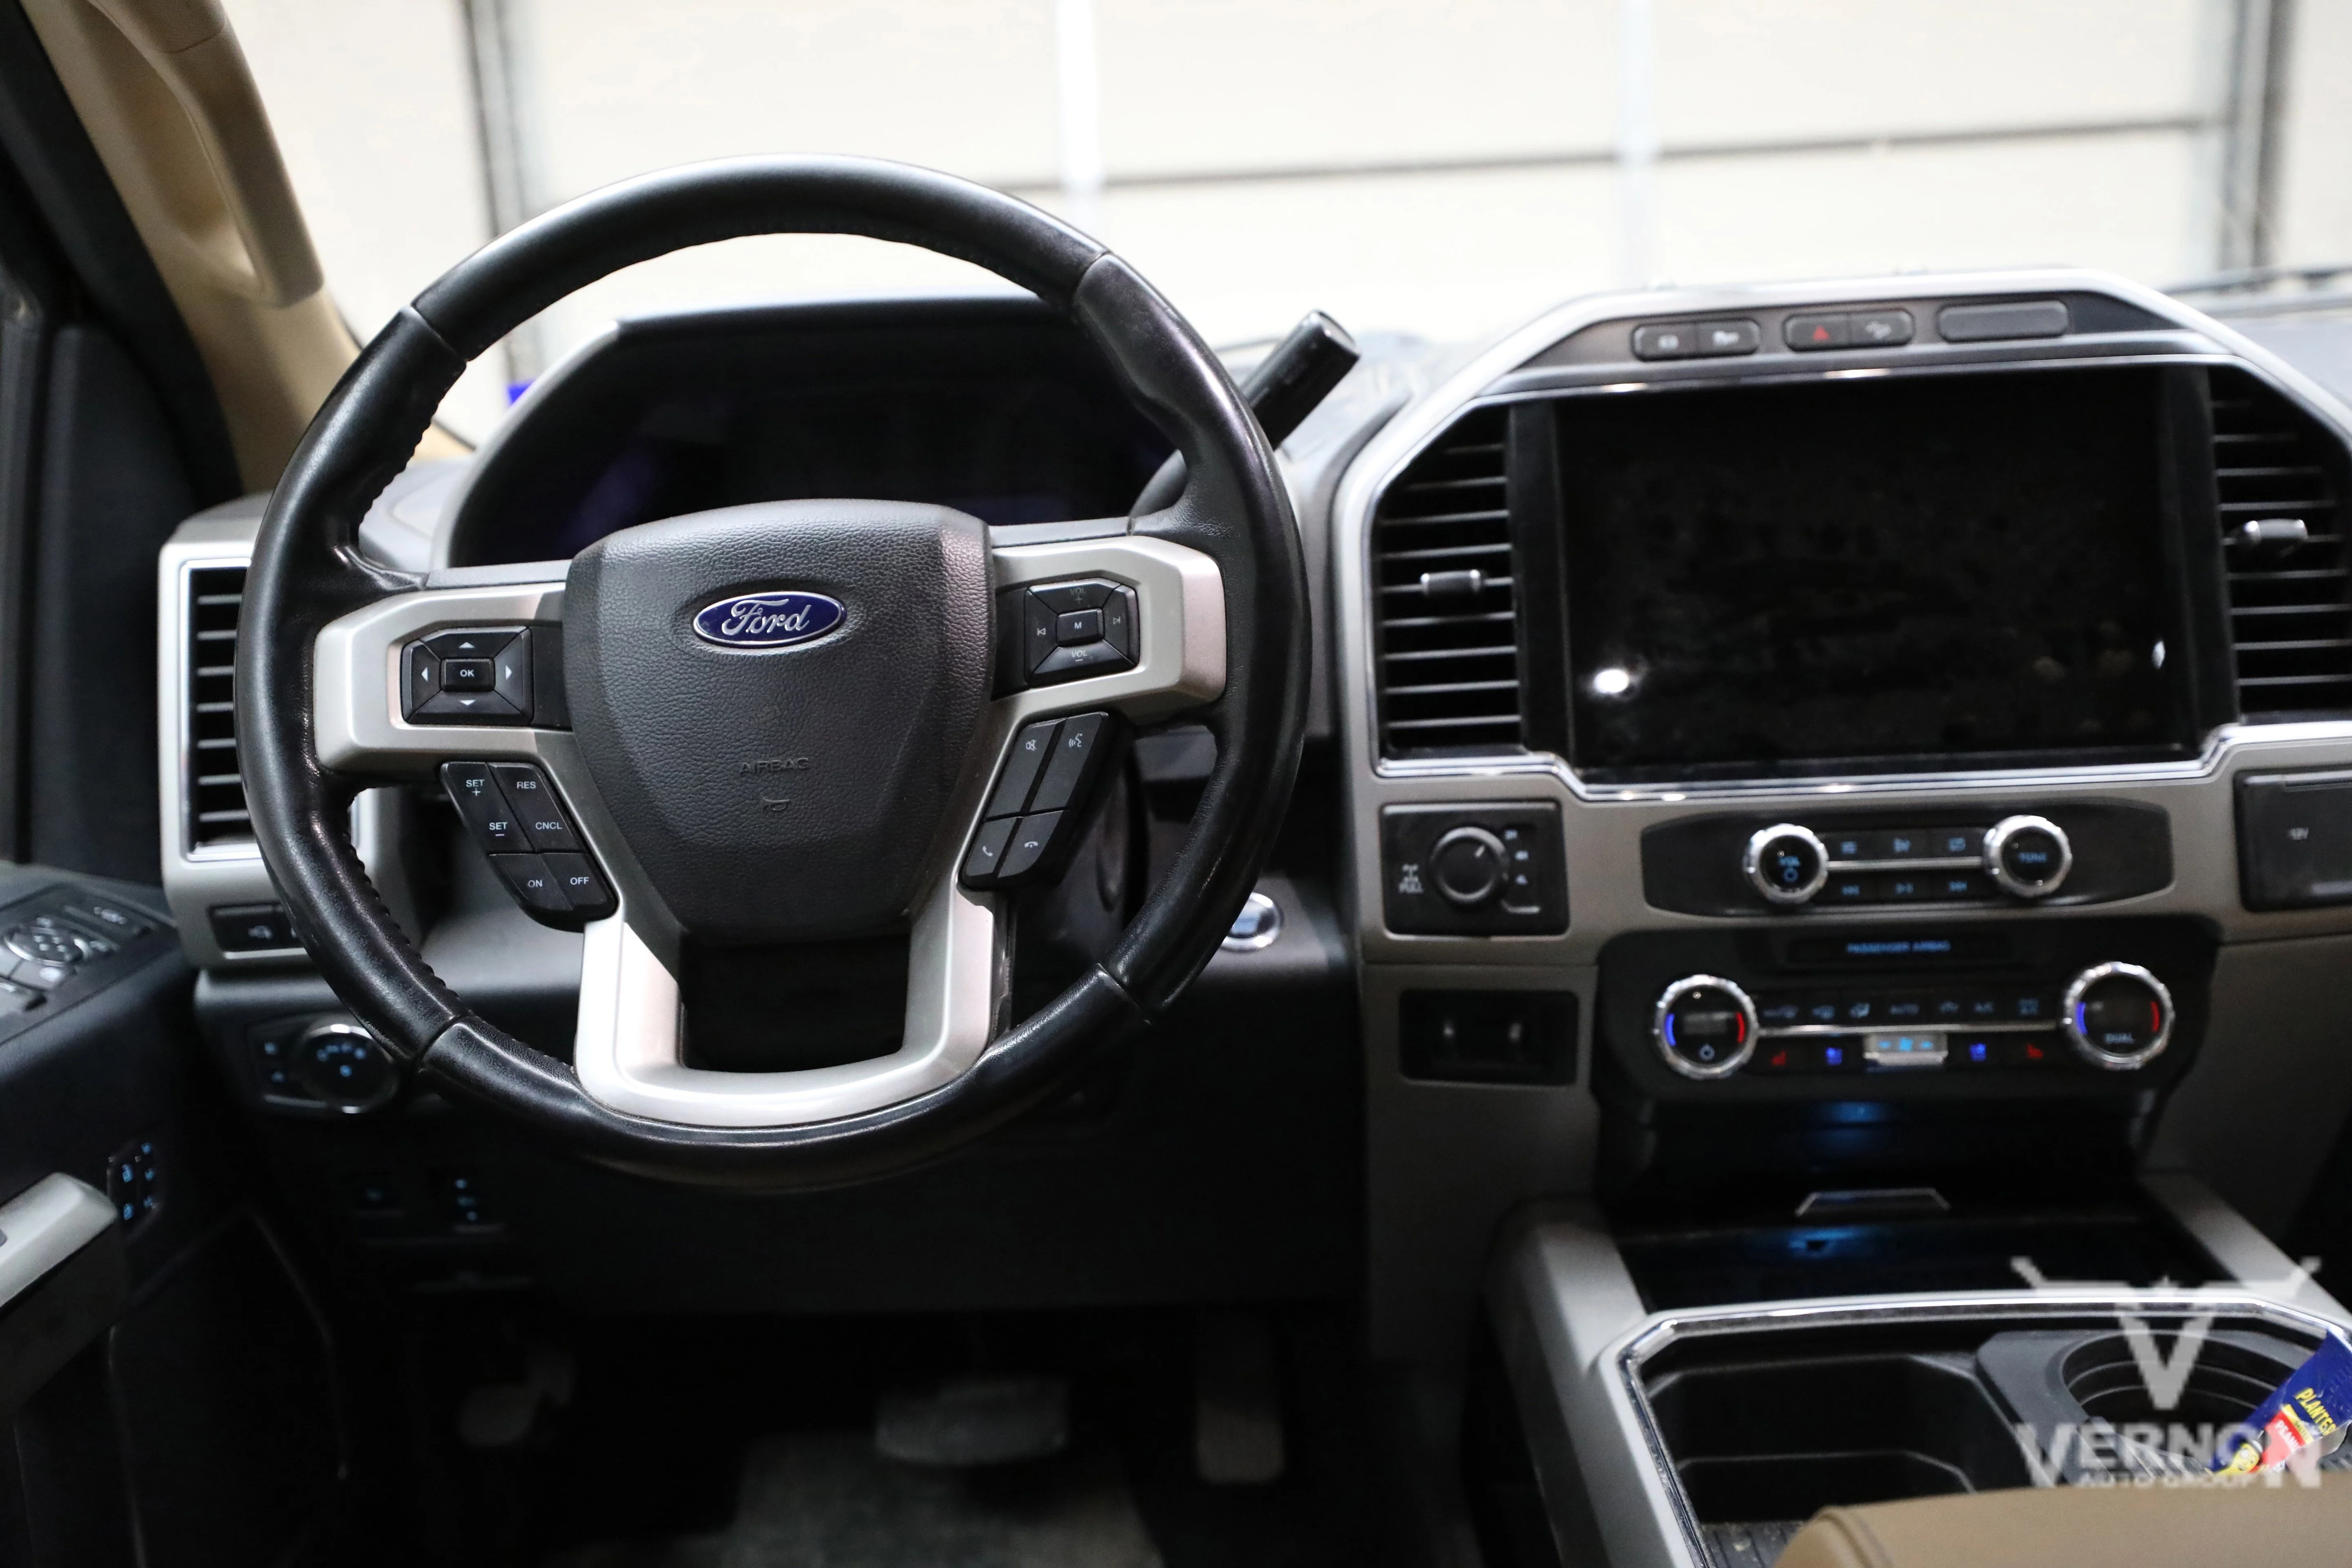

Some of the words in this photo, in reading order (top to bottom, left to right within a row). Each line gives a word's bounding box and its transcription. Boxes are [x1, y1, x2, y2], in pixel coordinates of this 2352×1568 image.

[722, 599, 812, 635] Ford
[1071, 650, 1088, 658] VOL
[460, 669, 474, 677] OK
[466, 779, 485, 788] SET
[516, 781, 537, 790] RES
[489, 822, 508, 831] SET
[535, 822, 563, 831] CNCL
[528, 880, 543, 888] ON
[570, 877, 590, 885] OFF
